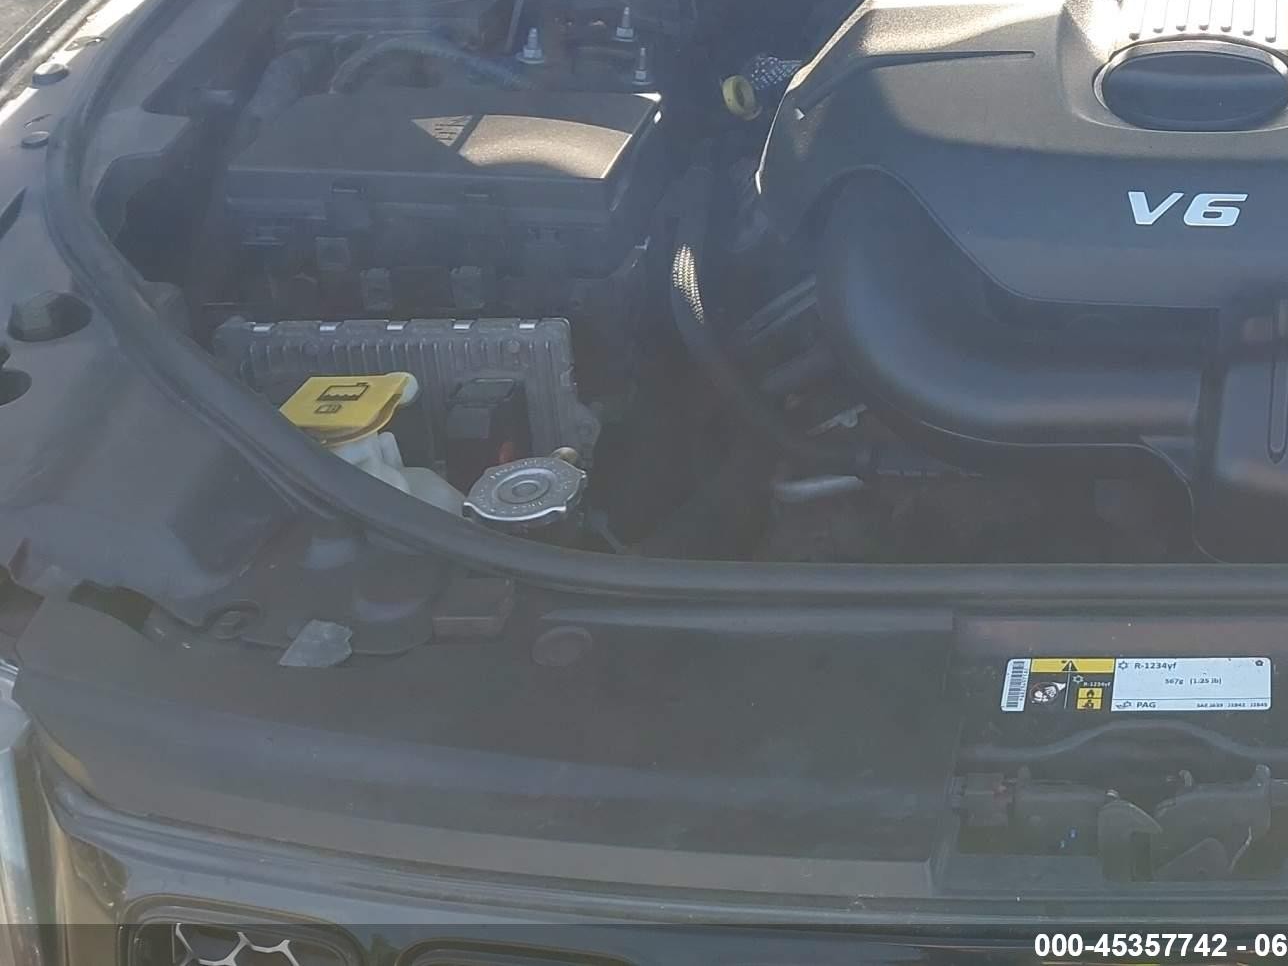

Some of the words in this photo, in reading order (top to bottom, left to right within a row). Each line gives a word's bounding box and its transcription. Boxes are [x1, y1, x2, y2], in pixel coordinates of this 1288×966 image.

[1127, 191, 1248, 226] V6
[1134, 662, 1177, 671] R-1234yf
[1136, 701, 1156, 709] PAG
